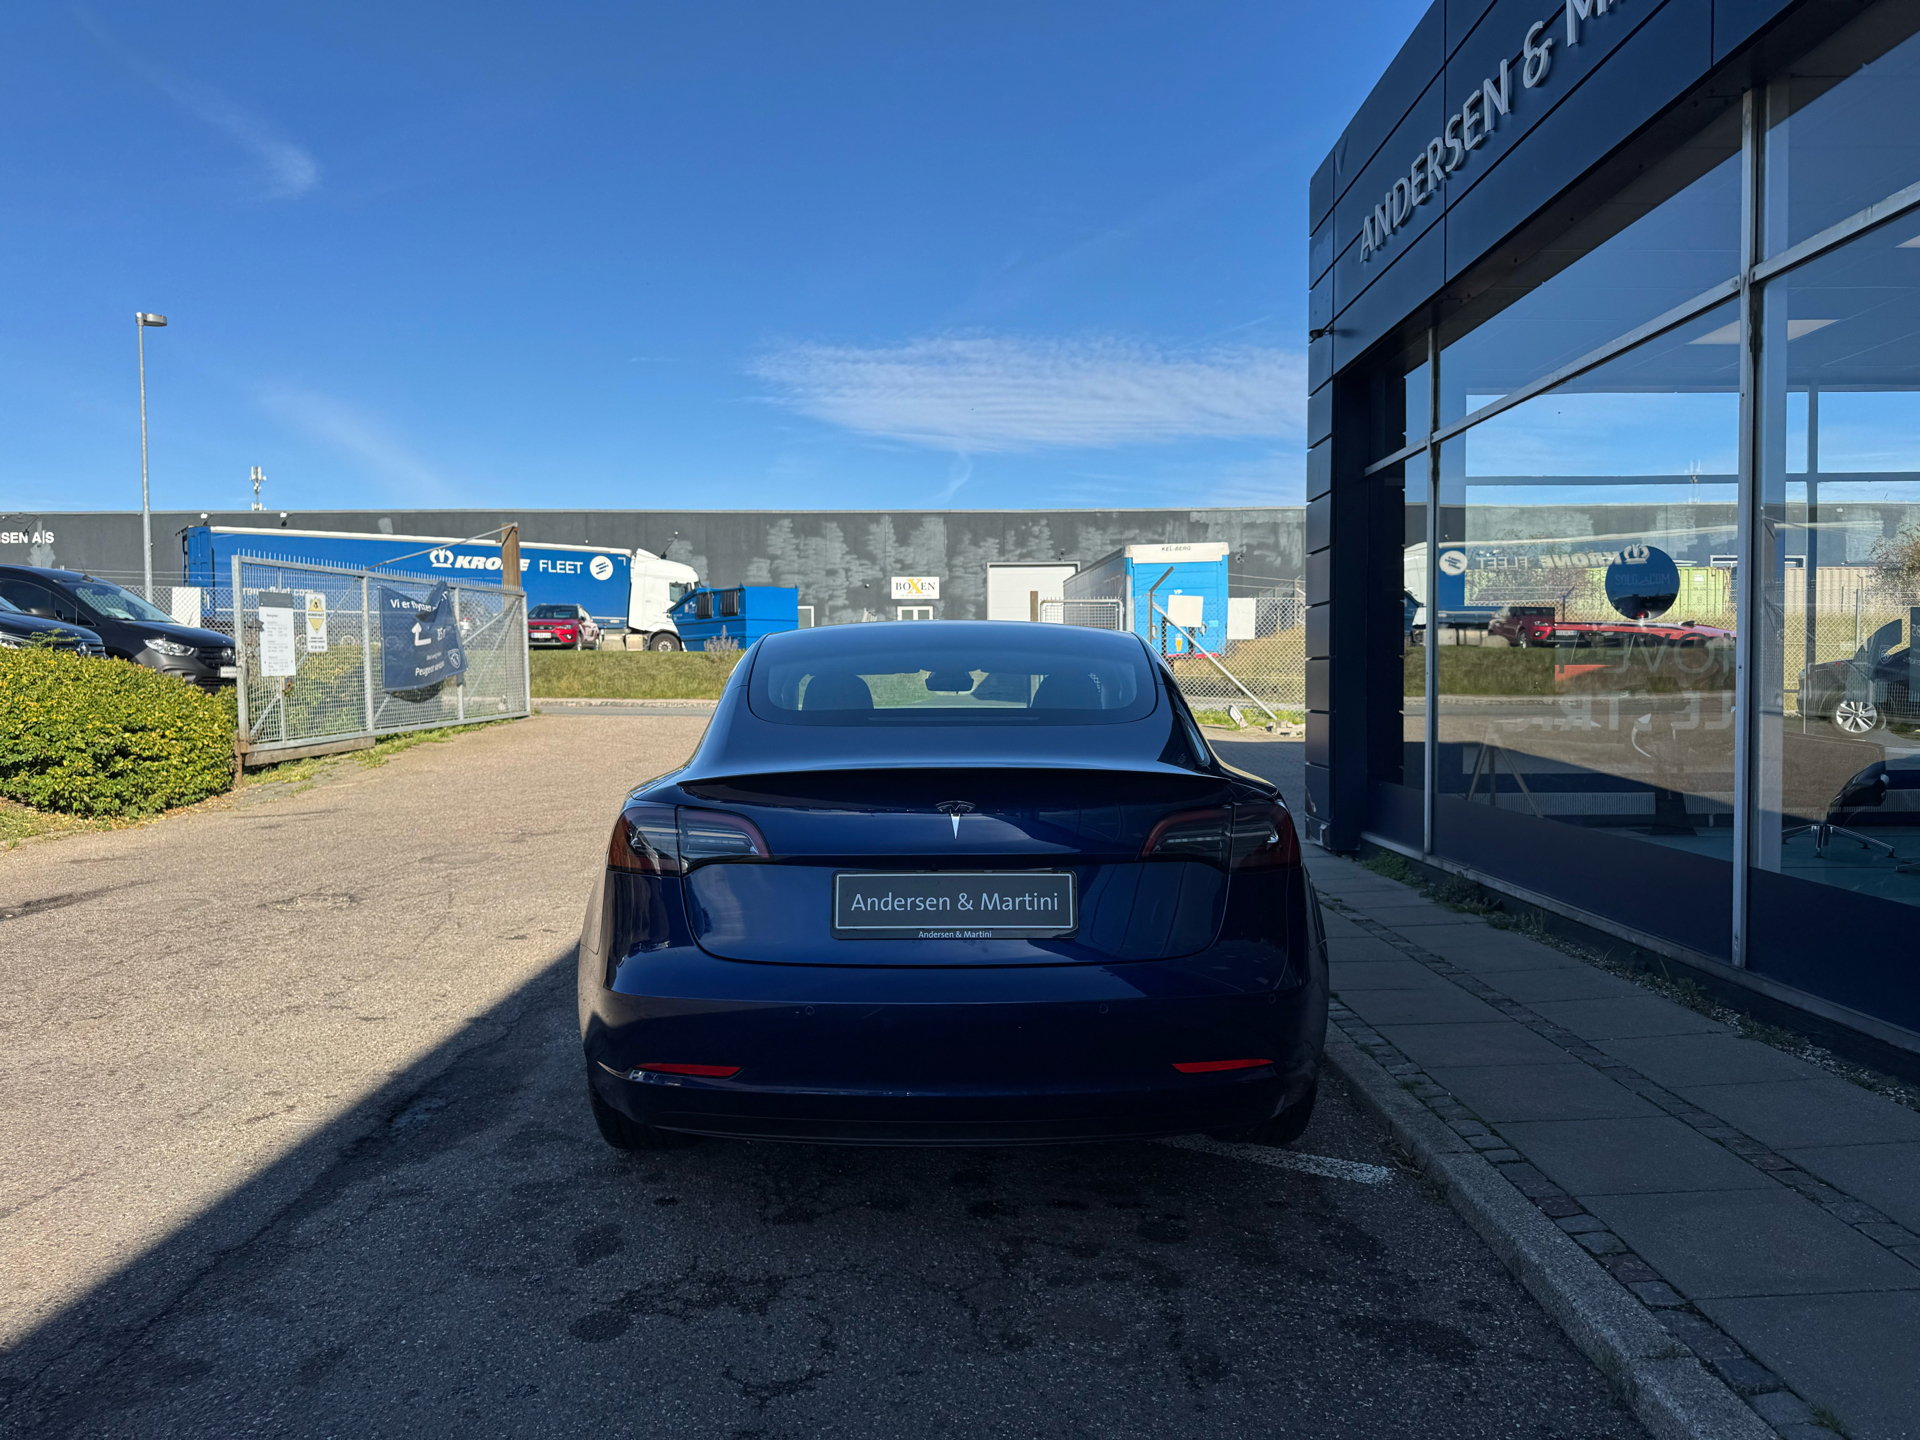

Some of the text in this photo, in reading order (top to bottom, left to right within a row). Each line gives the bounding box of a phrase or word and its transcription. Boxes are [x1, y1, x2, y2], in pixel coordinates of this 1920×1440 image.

[1359, 58, 1511, 263] ANDERSEN
[1522, 20, 1553, 89] &
[0, 531, 29, 544] SEN
[455, 555, 584, 575] KROE FLEET
[895, 578, 936, 594] BOXEN
[390, 598, 401, 609] Vi
[401, 601, 411, 609] er
[851, 892, 1058, 911] Andersen & Martini
[918, 930, 992, 939] Andersen & Martini
